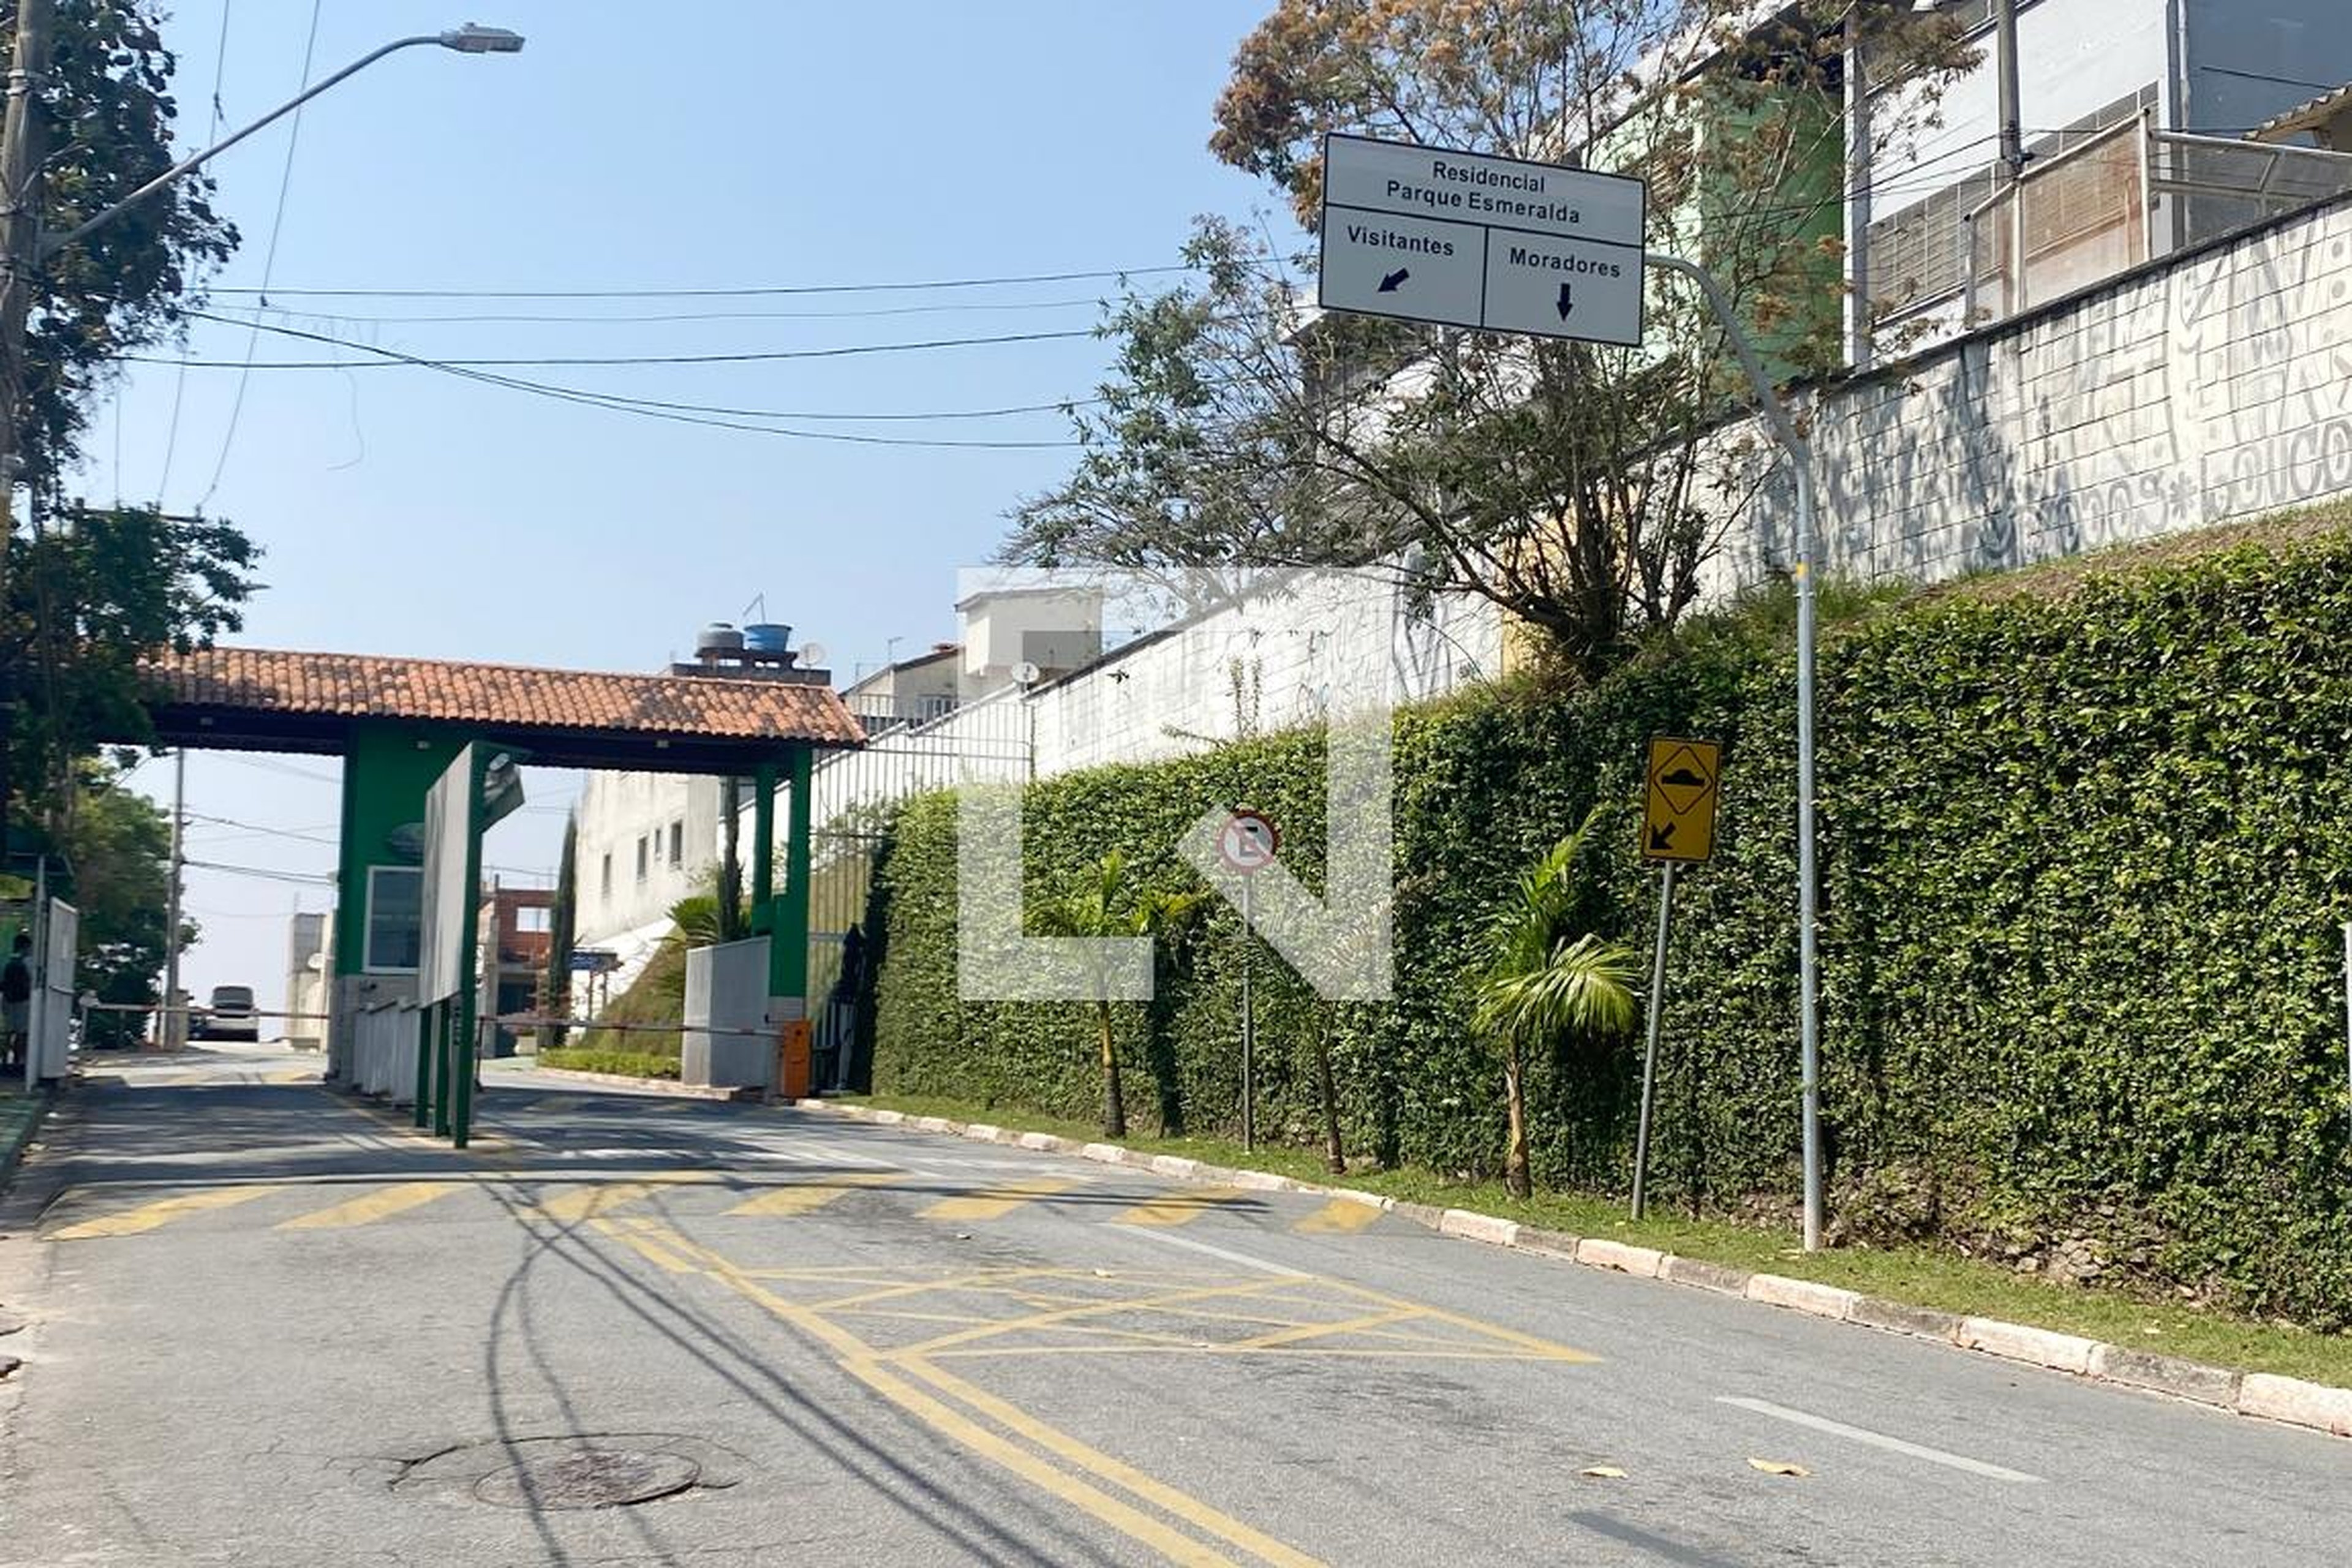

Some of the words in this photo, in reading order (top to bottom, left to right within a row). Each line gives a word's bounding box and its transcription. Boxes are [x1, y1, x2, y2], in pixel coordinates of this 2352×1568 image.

[1433, 160, 1545, 193] Residencial
[1387, 180, 1462, 207] Parque
[1469, 192, 1580, 223] Esmeralda
[1348, 225, 1454, 256] Visitantes
[1510, 247, 1621, 277] Moradores
